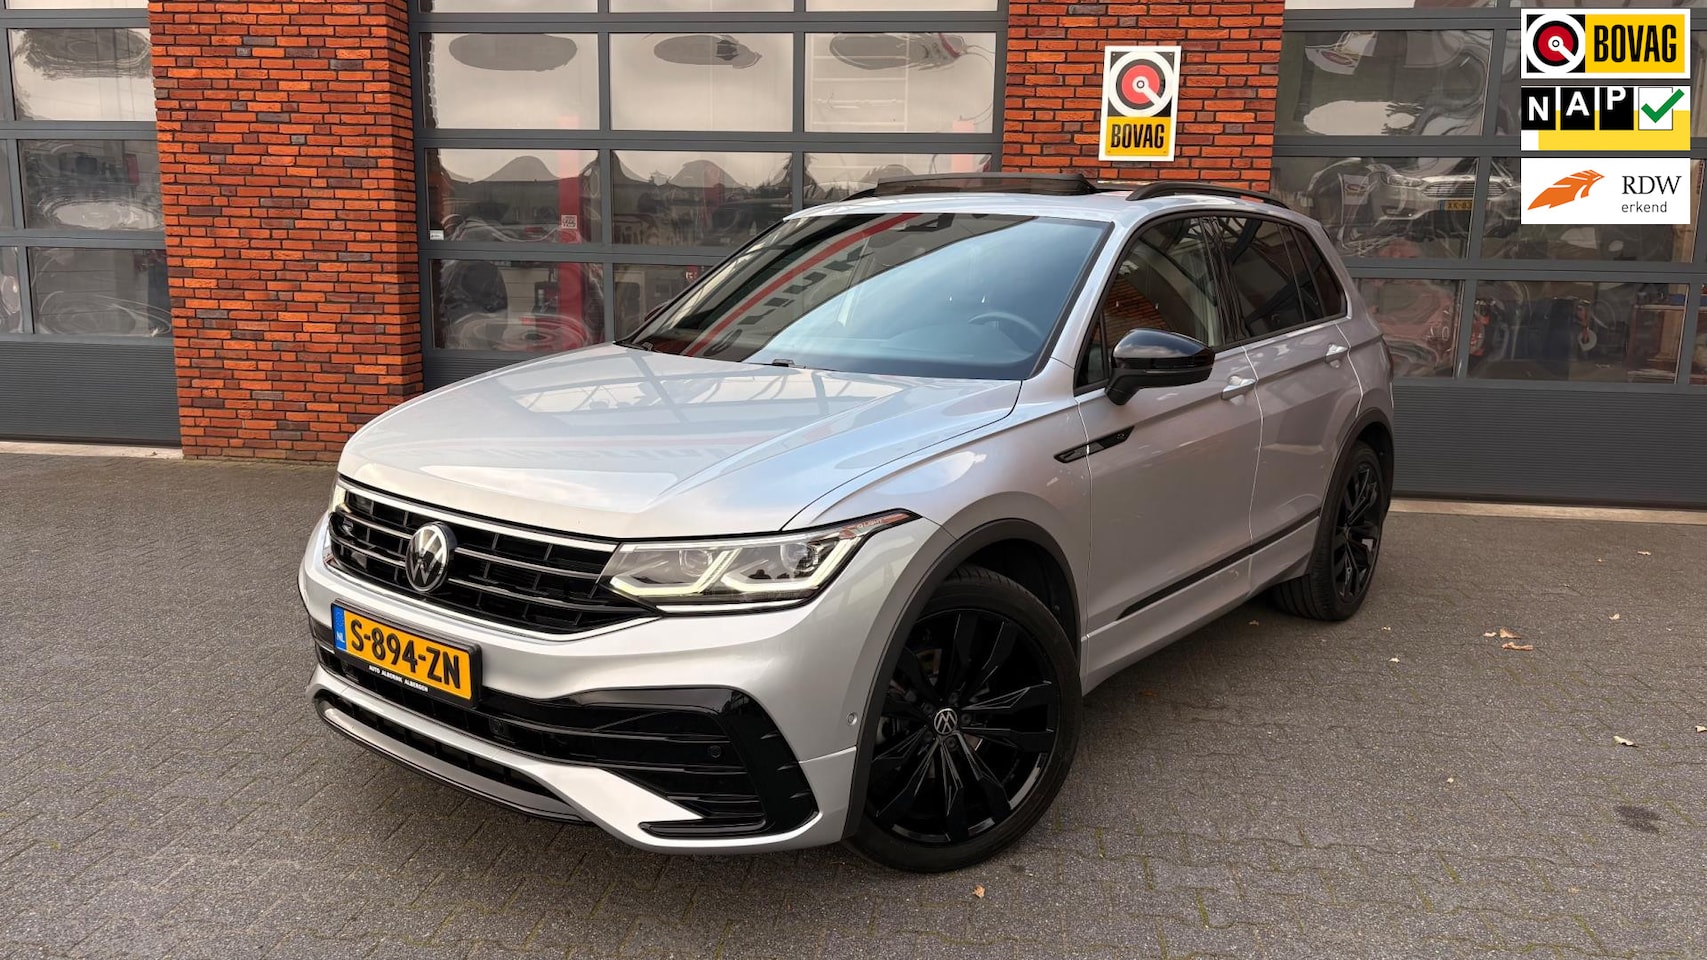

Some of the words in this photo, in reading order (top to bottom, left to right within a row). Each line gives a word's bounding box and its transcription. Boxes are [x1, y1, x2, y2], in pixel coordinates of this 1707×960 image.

[1110, 123, 1165, 149] BOVAG
[335, 630, 346, 643] NL
[350, 619, 461, 690] S-894-ZN
[368, 664, 381, 675] AUTO
